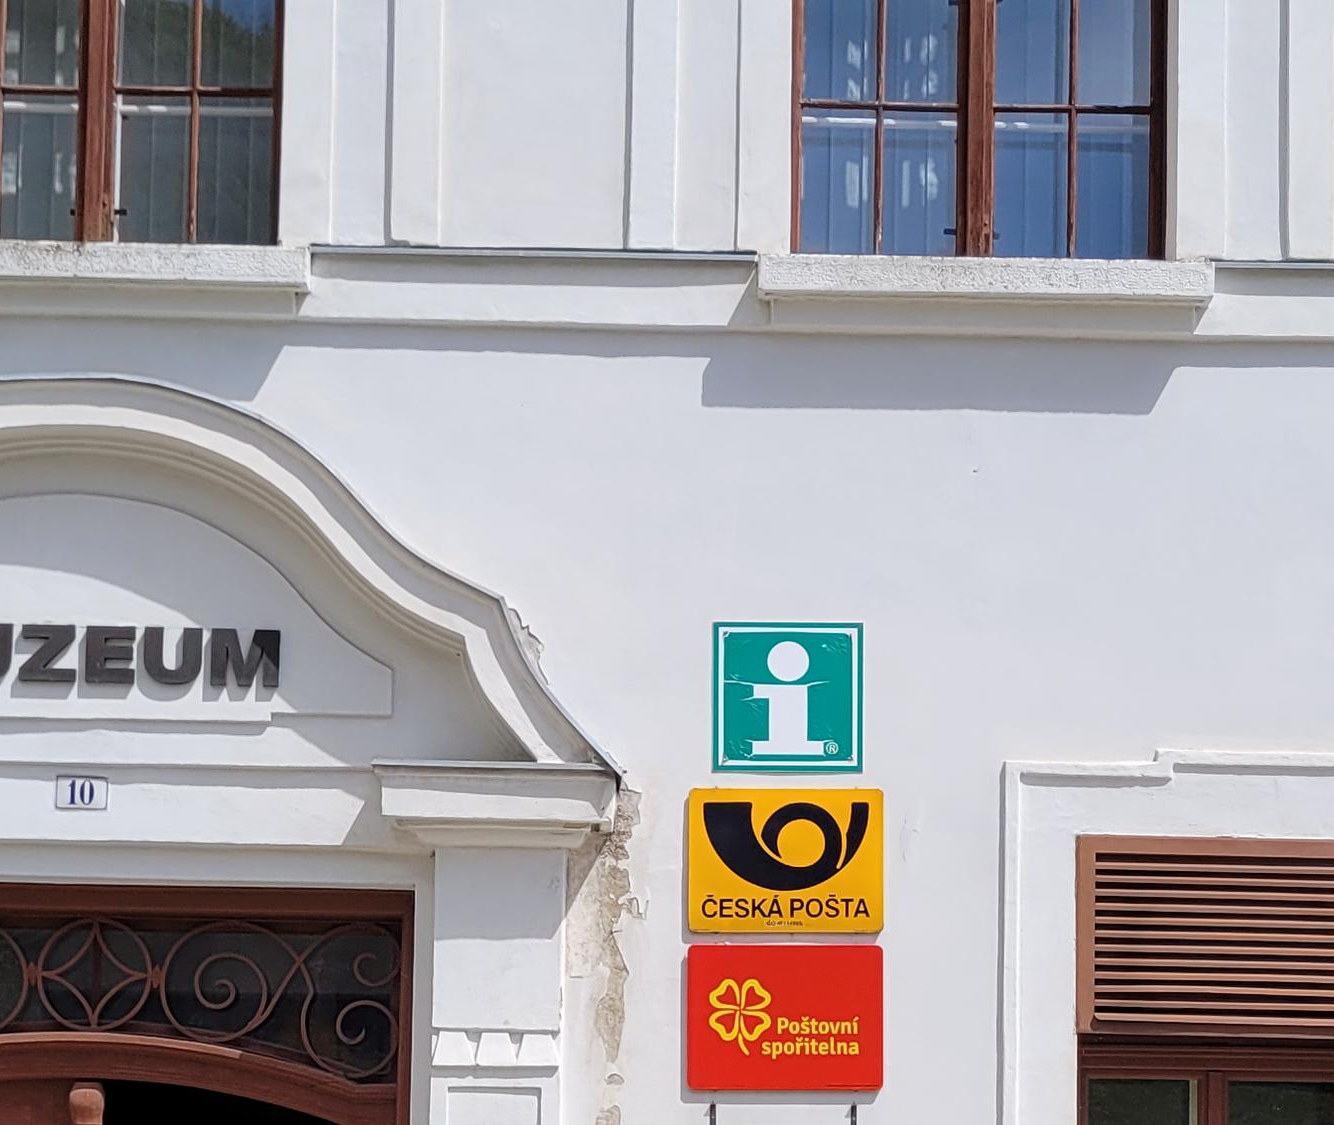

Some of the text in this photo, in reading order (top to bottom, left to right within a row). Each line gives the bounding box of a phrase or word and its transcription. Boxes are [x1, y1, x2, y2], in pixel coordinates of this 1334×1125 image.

[67, 779, 95, 806] 10
[701, 894, 870, 918] ČESKÁ POŠTA
[776, 1016, 860, 1035] Poštovní
[761, 1036, 860, 1060] spořitelna
